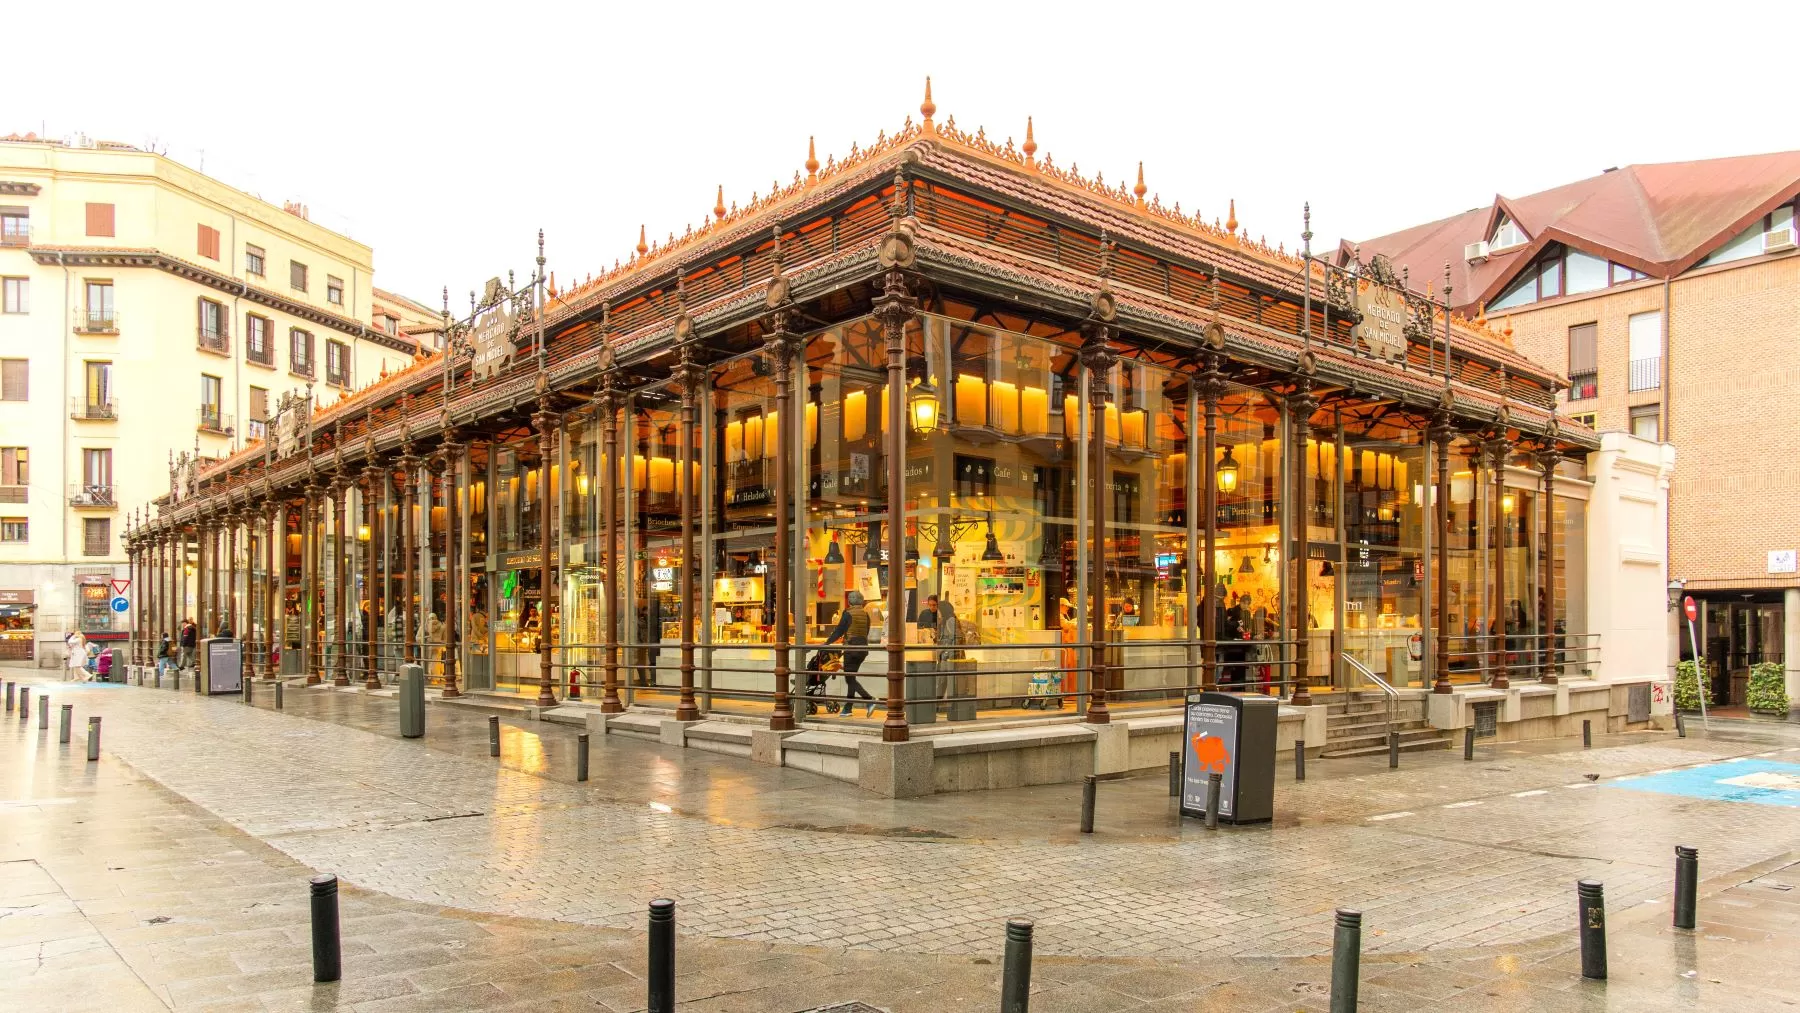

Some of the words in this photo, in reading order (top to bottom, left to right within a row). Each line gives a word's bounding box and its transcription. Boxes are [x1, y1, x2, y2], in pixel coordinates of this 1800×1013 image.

[1367, 303, 1401, 324] MERCADO
[478, 322, 505, 343] MERCADO
[1379, 320, 1389, 330] DE
[1364, 326, 1378, 340] SAN
[1379, 331, 1402, 348] MIGUEL
[475, 353, 486, 366] SAN
[486, 346, 504, 362] MIGUEL
